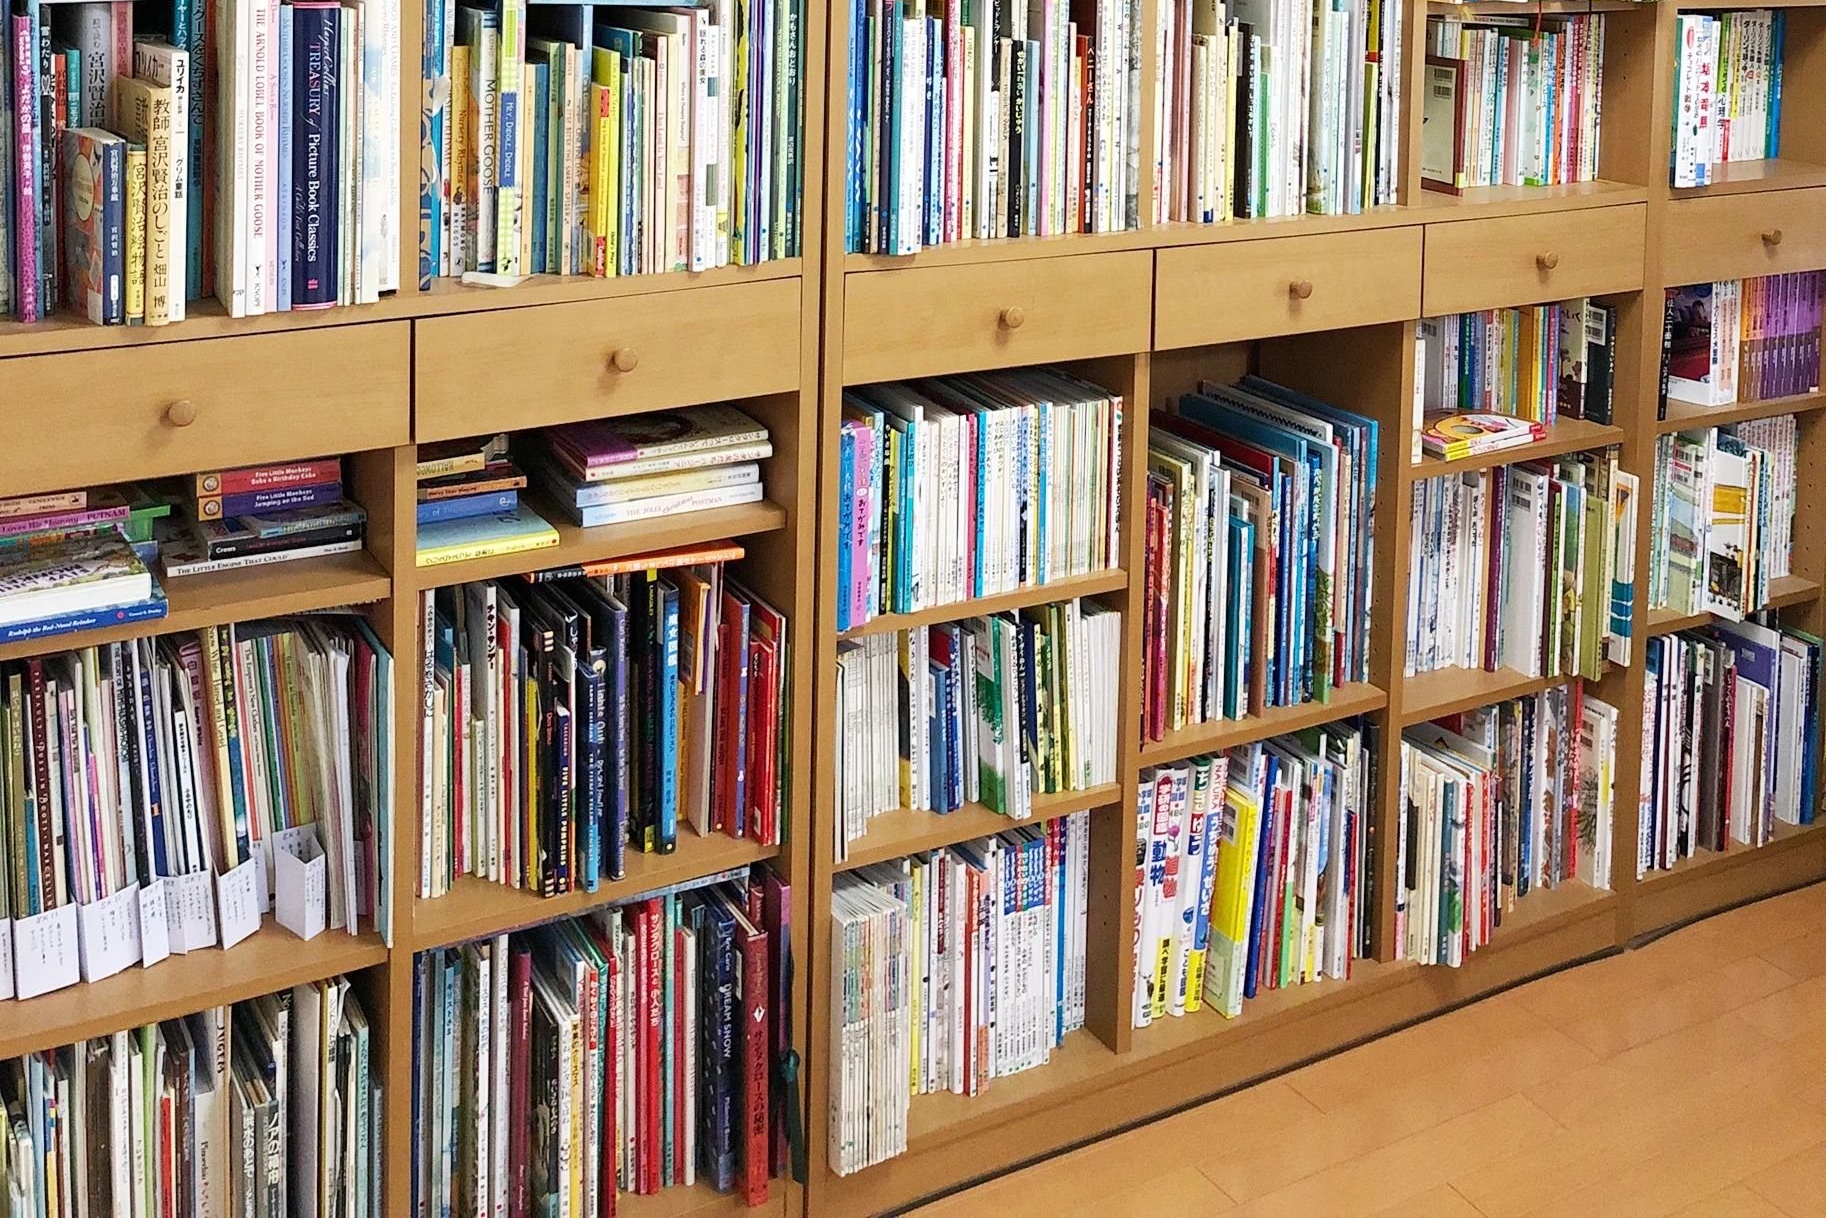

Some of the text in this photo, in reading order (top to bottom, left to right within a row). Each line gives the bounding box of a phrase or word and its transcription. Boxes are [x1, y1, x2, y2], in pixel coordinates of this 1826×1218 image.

[788, 12, 799, 86] かもさんおとおり
[175, 58, 186, 95] ユリイカ
[253, 8, 266, 240] THE ARNOLD LOBEL BOOK OF MOTHER GOOSE
[482, 78, 497, 195] MOTHER GOOSE
[307, 41, 321, 263] TREASURY Picture Book Classics
[456, 148, 468, 184] Rhymes
[151, 97, 171, 309] 教師 宮沢賢治のしごと 畑山 博
[87, 508, 127, 521] PUTNAM
[177, 554, 290, 575] THE LITTLE ENGINE THAT COULD
[215, 545, 237, 554] Crews
[486, 604, 496, 671] チキン・サンデー
[666, 612, 679, 667] 魔女図鑑
[560, 820, 568, 867] PUMPKINS
[1149, 838, 1167, 886] 動物
[1161, 855, 1179, 898] 植物
[719, 983, 732, 1022] DREAM
[722, 1023, 732, 1059] SNOW
